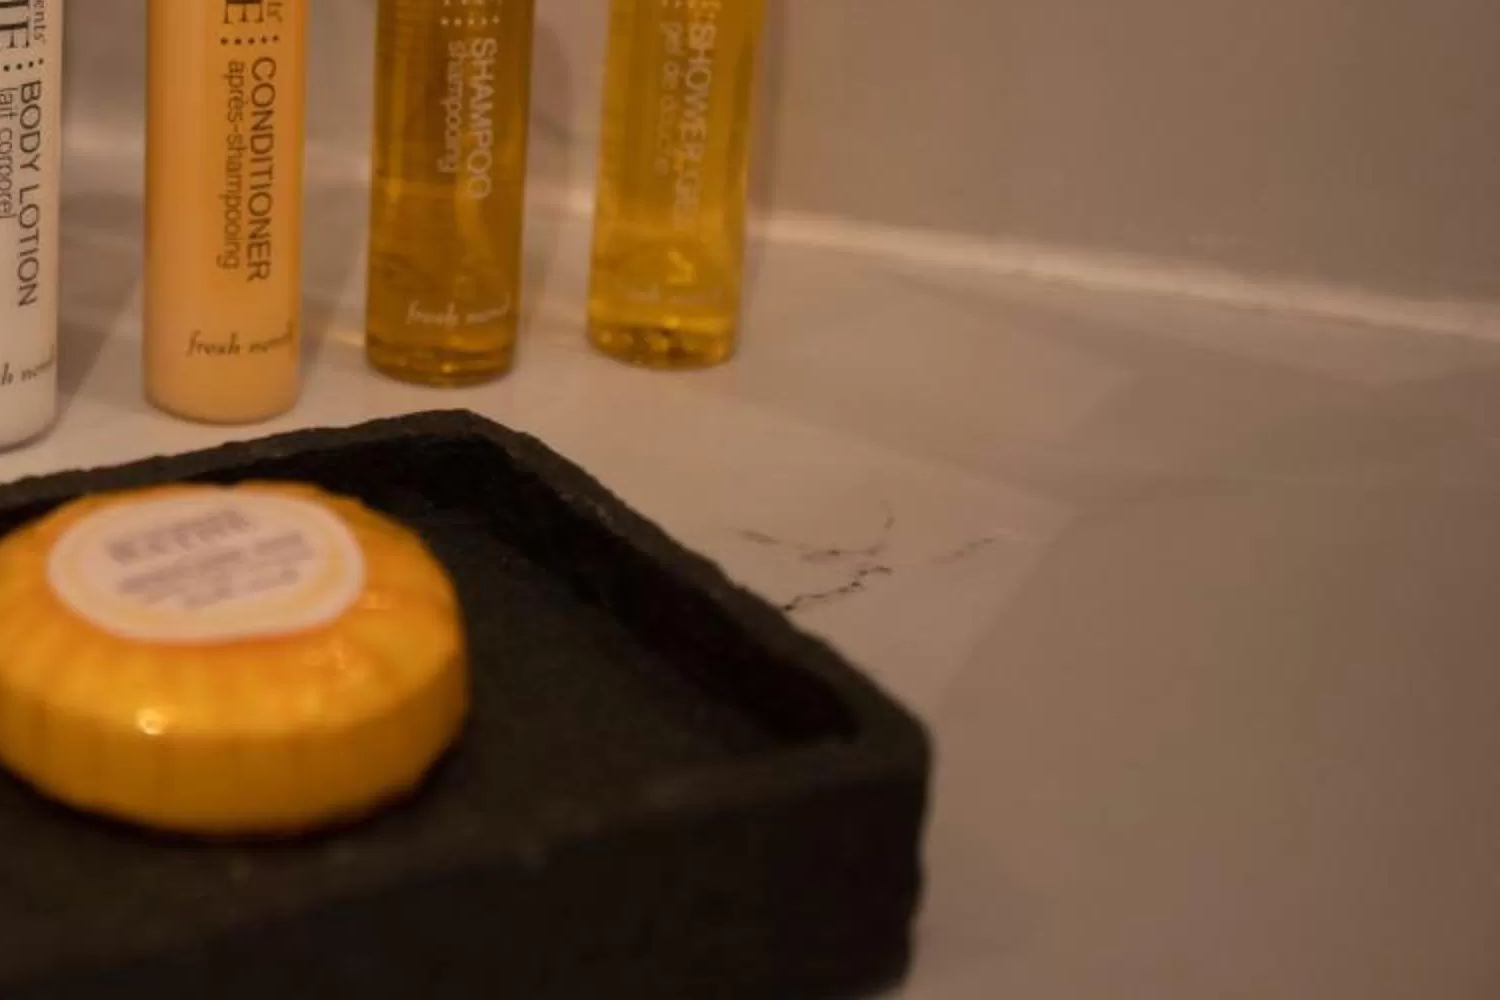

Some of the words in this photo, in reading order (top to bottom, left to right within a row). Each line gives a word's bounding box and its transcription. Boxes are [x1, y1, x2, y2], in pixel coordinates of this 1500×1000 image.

[19, 80, 42, 171] BODY
[438, 40, 467, 173] shampooing
[467, 37, 497, 199] SHAMPOO
[679, 22, 716, 161] SHOWER
[217, 61, 248, 269] après-shampooing
[246, 57, 277, 281] CONDITIONER
[17, 184, 40, 306] LOTION
